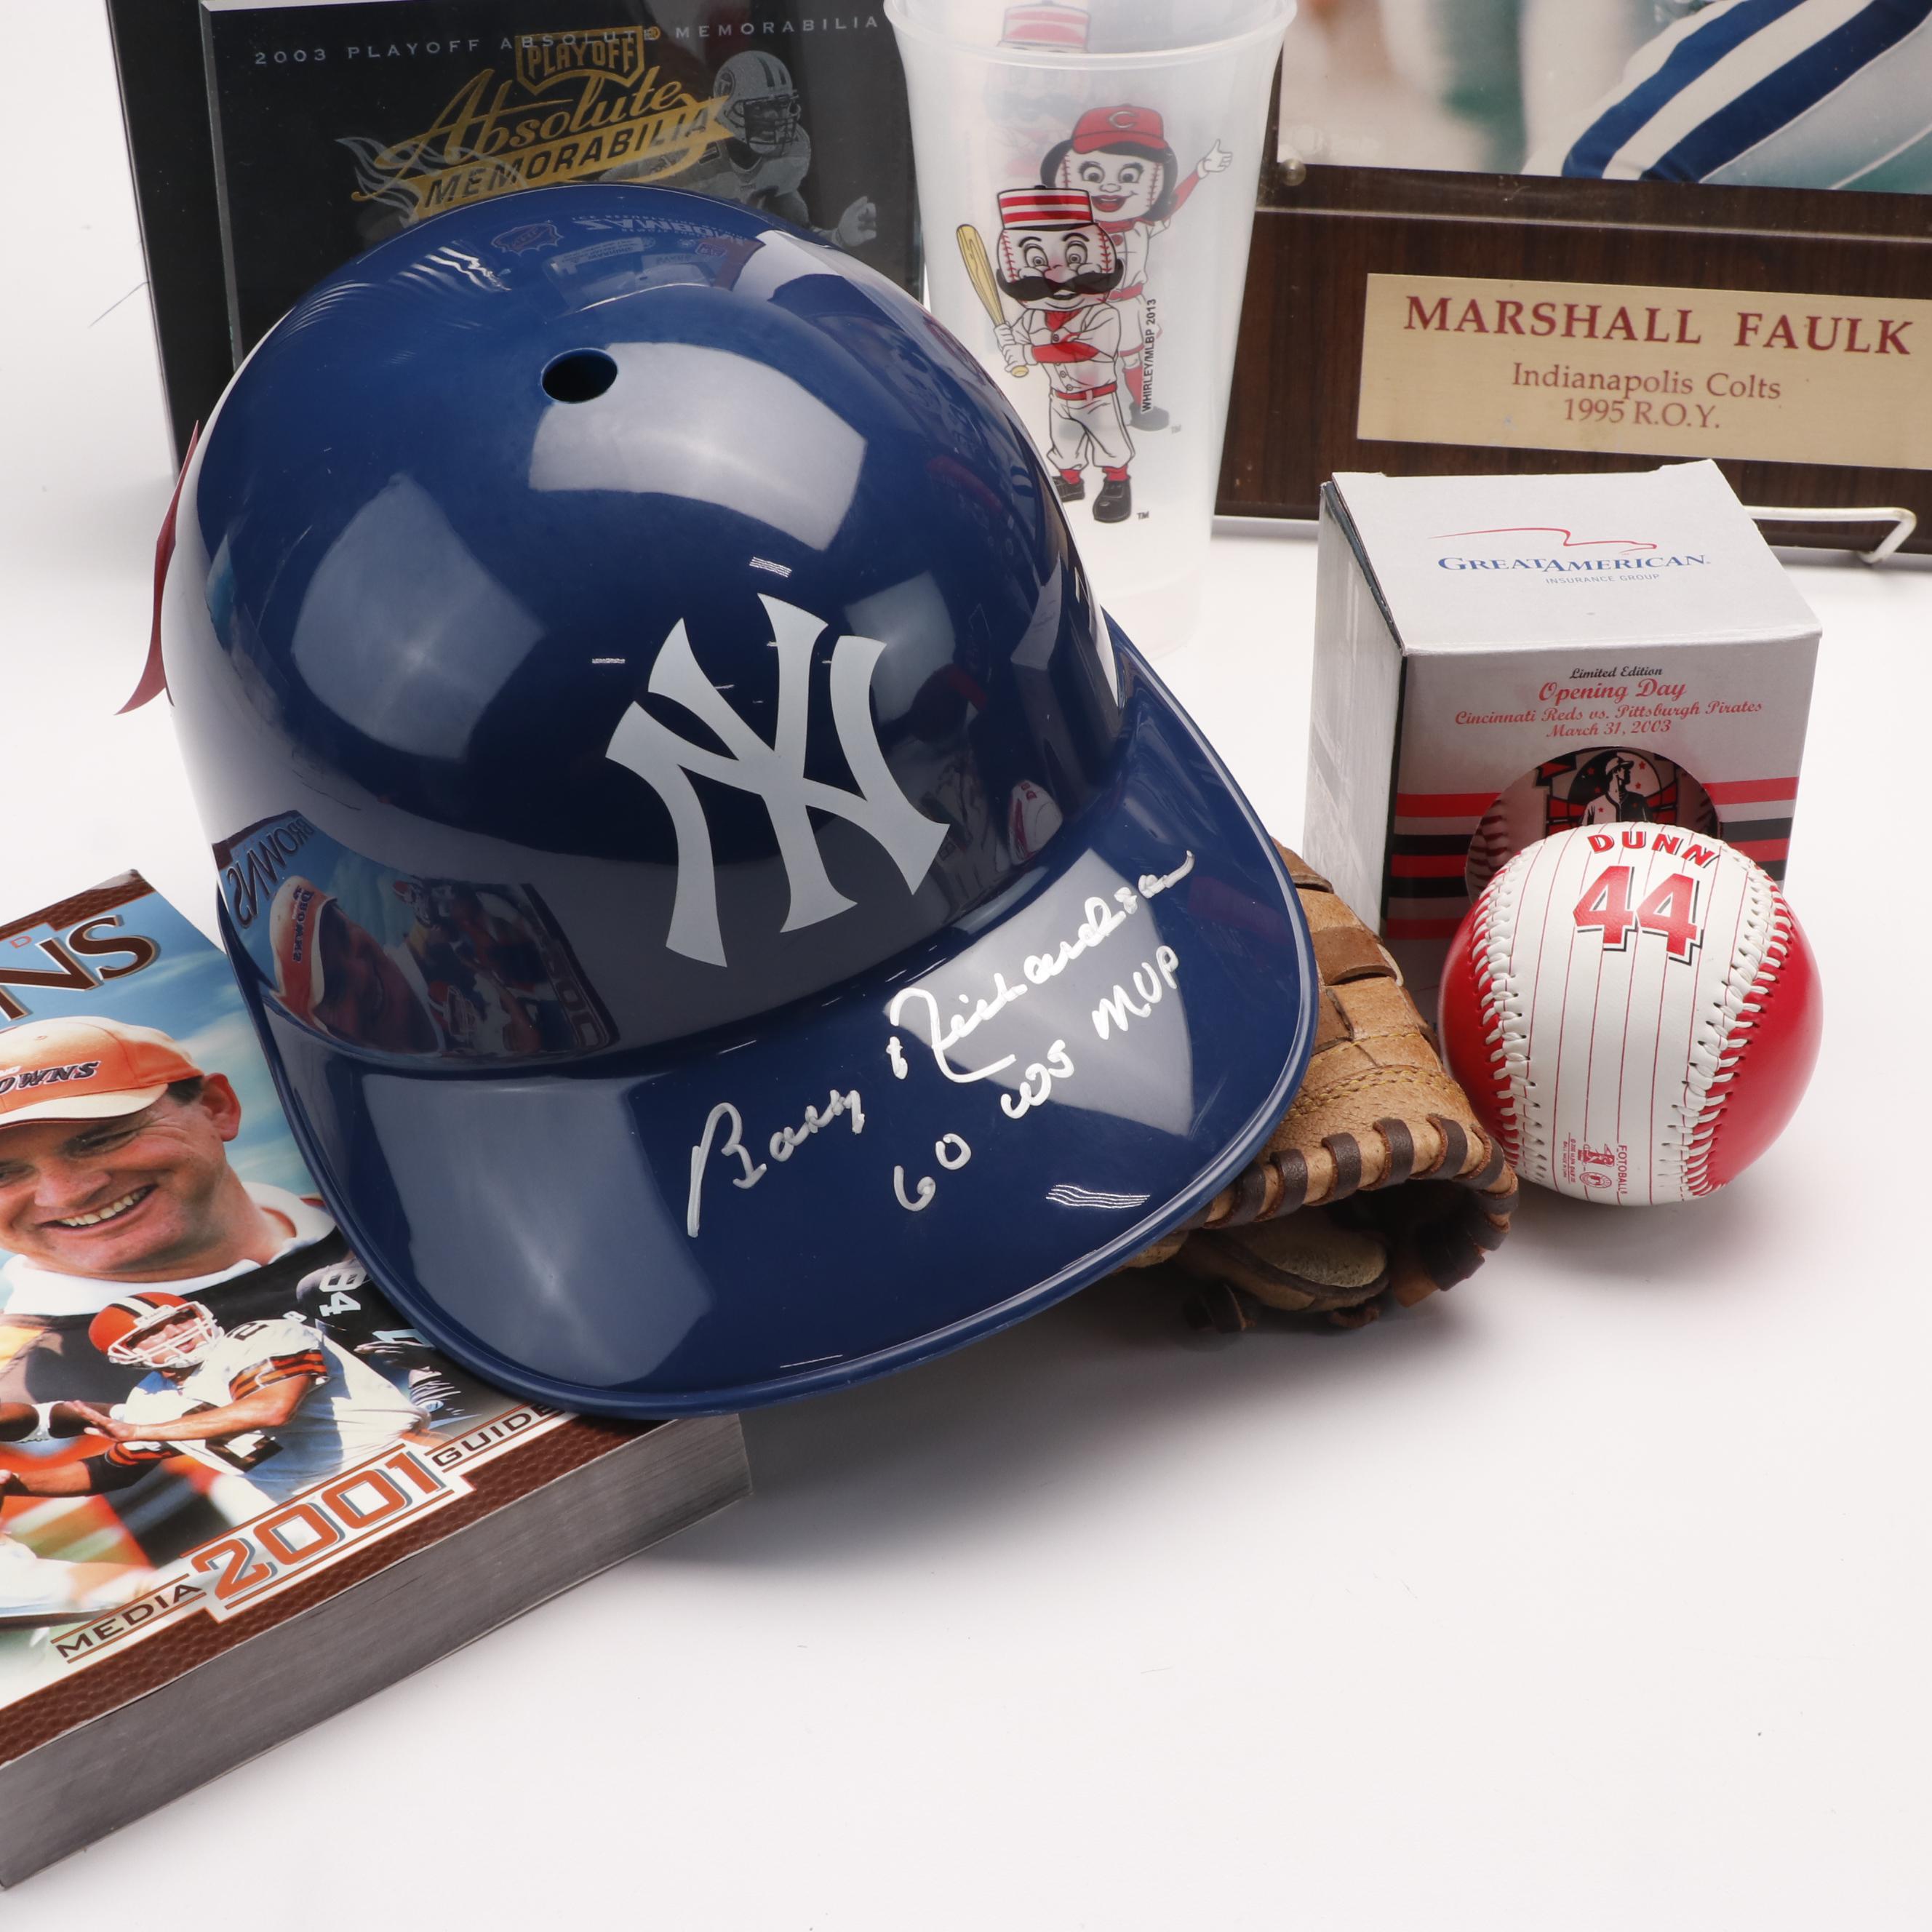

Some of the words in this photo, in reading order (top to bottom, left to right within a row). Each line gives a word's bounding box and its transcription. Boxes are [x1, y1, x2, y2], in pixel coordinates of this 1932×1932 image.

[255, 48, 326, 65] 2003
[347, 39, 480, 59] PLAYOFF
[500, 29, 656, 49] ABSOLUTE
[676, 16, 878, 39] MEMORABILIA
[527, 37, 635, 79] PLAYOFF
[351, 67, 688, 201] Absolute
[425, 108, 710, 209] MEMORABILIA
[1146, 298, 1157, 325] 2013
[1403, 295, 1702, 345] MARSHALL
[1734, 312, 1915, 356] FAULK
[1142, 326, 1156, 413] WHIRLEY/MLBP
[1512, 362, 1693, 399] Indianapolis
[1707, 372, 1781, 400] Colts
[1564, 397, 1625, 423] 1995
[1634, 401, 1721, 428] R.O.Y.
[1545, 575, 1616, 584] INSURANCE
[1620, 573, 1661, 581] GROUP
[1569, 667, 1617, 679] Limited
[1621, 666, 1664, 678] Edition
[1538, 678, 1629, 706] Opening
[1636, 678, 1688, 701] Day
[1455, 710, 1536, 725] Cincinnati
[1541, 707, 1584, 722] Reds
[1589, 710, 1610, 720] vs.
[1615, 703, 1701, 723] Pittsburgh
[1705, 700, 1763, 716] Pirates
[1546, 723, 1599, 738] March
[1603, 722, 1626, 736] 31,
[1630, 719, 1672, 734] 2003
[1586, 831, 1721, 869] DUNN
[1572, 866, 1704, 966] 44
[55, 1584, 202, 1658] MEDIA
[191, 1450, 447, 1601] 2001
